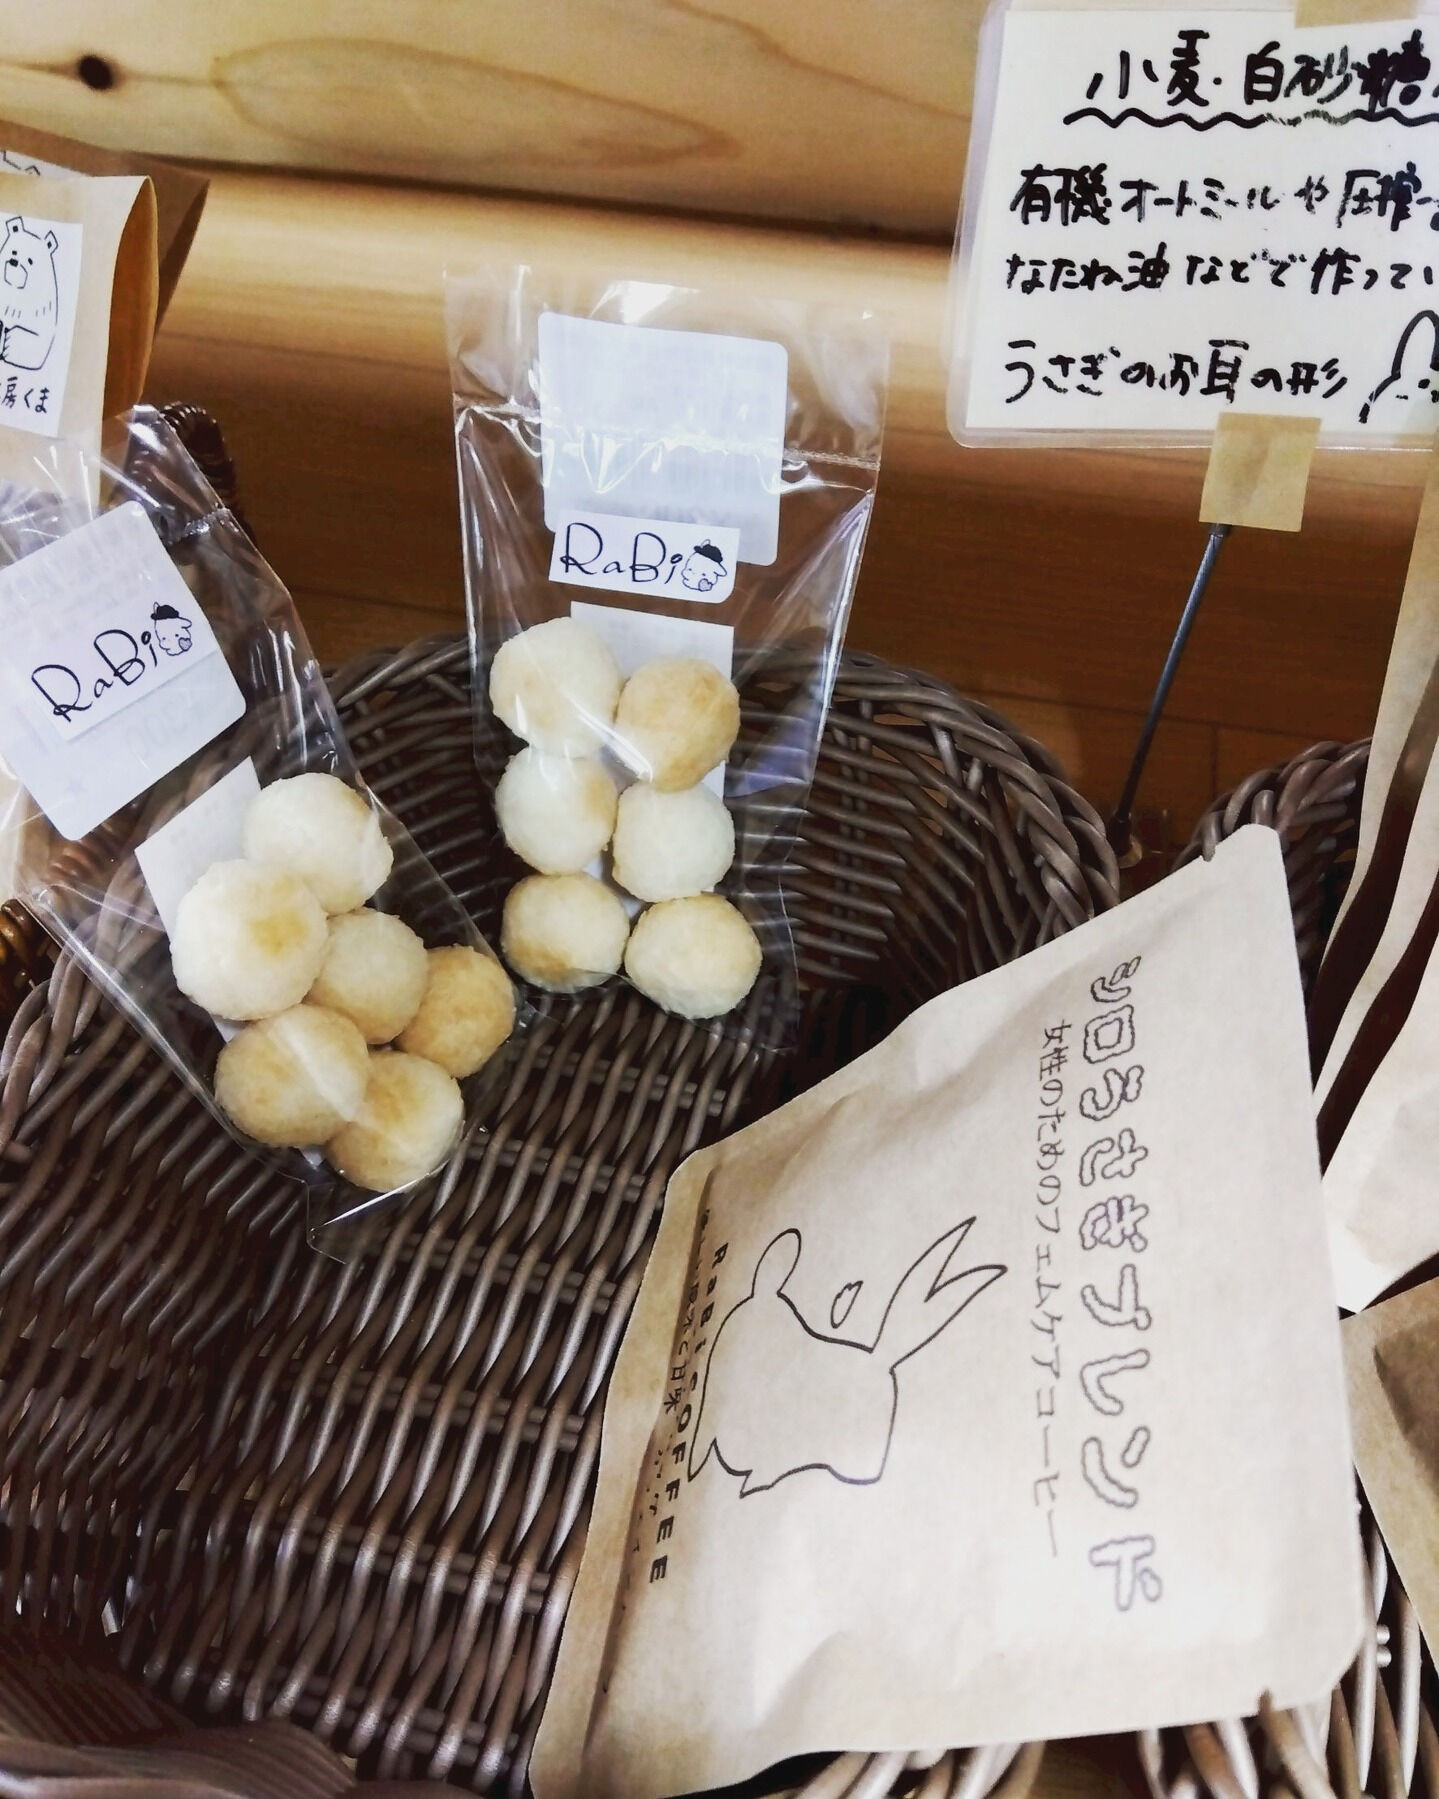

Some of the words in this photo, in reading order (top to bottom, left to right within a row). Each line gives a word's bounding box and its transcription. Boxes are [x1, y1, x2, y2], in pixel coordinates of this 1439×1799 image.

[0, 376, 50, 414] 房くま
[559, 521, 683, 585] RaBi
[31, 629, 158, 722] RaBi
[1031, 1018, 1073, 1558] 女性のためのフェムケアコーヒー
[1079, 955, 1163, 1612] シロうさぎブレンド
